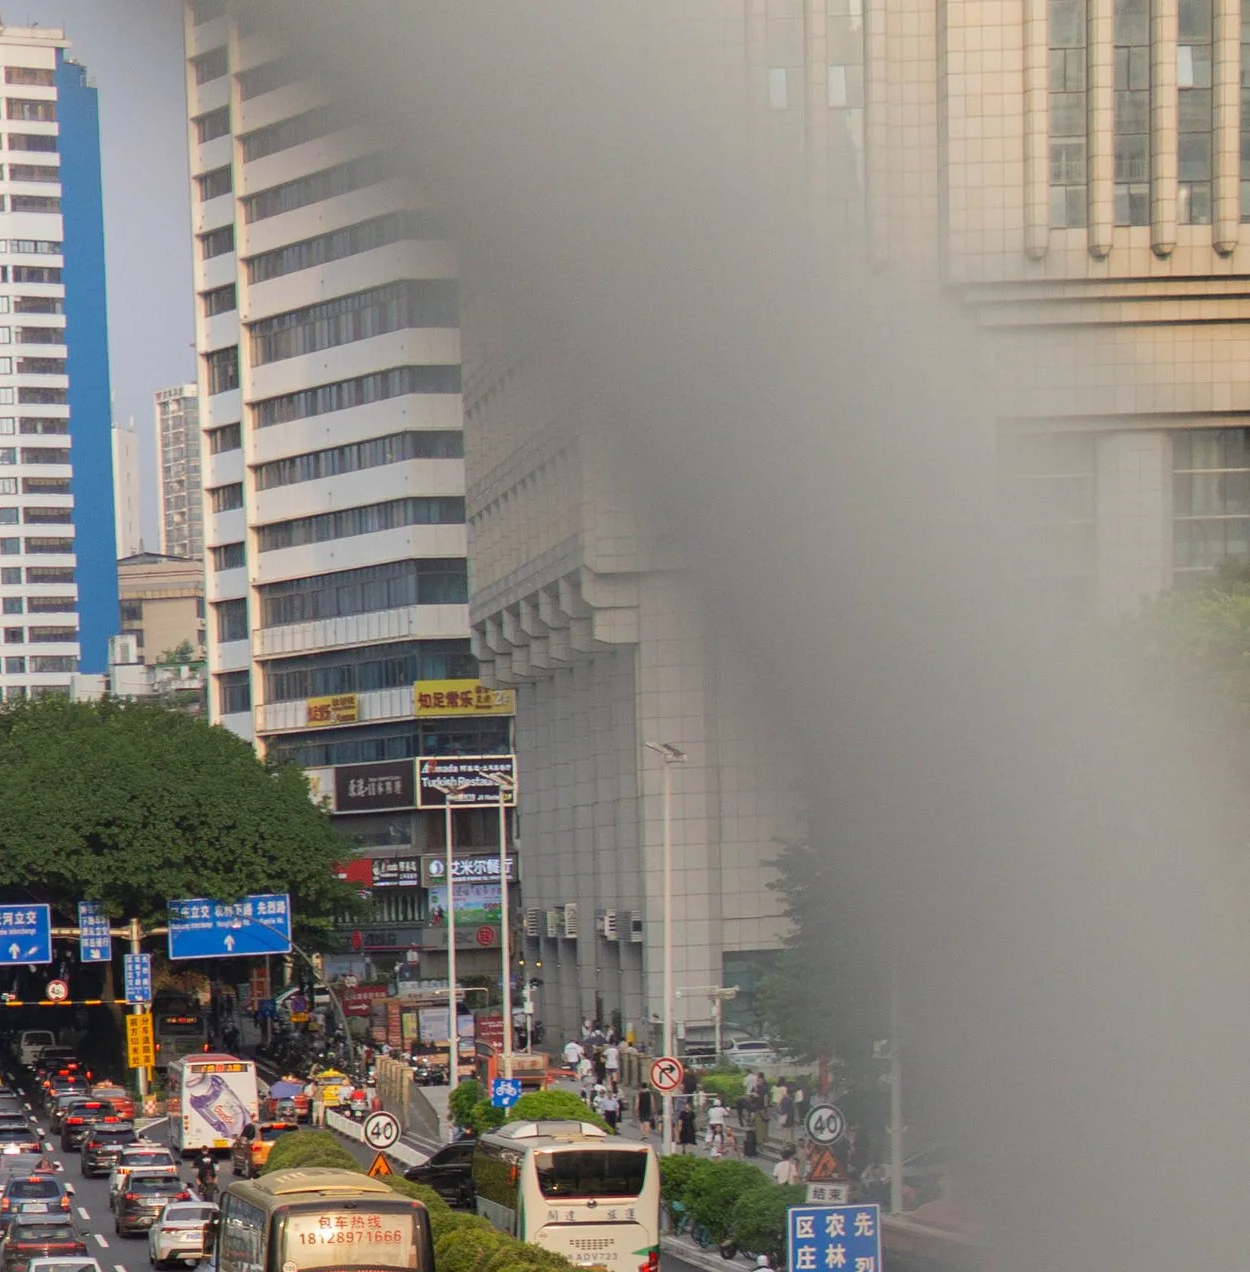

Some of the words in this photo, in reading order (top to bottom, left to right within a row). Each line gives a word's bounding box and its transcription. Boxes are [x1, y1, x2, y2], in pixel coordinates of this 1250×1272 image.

[371, 1121, 393, 1140] 40
[814, 1114, 837, 1134] 40
[813, 1187, 842, 1201] 结束
[318, 1215, 382, 1229] 包车热线
[299, 1230, 402, 1245] 18128971666
